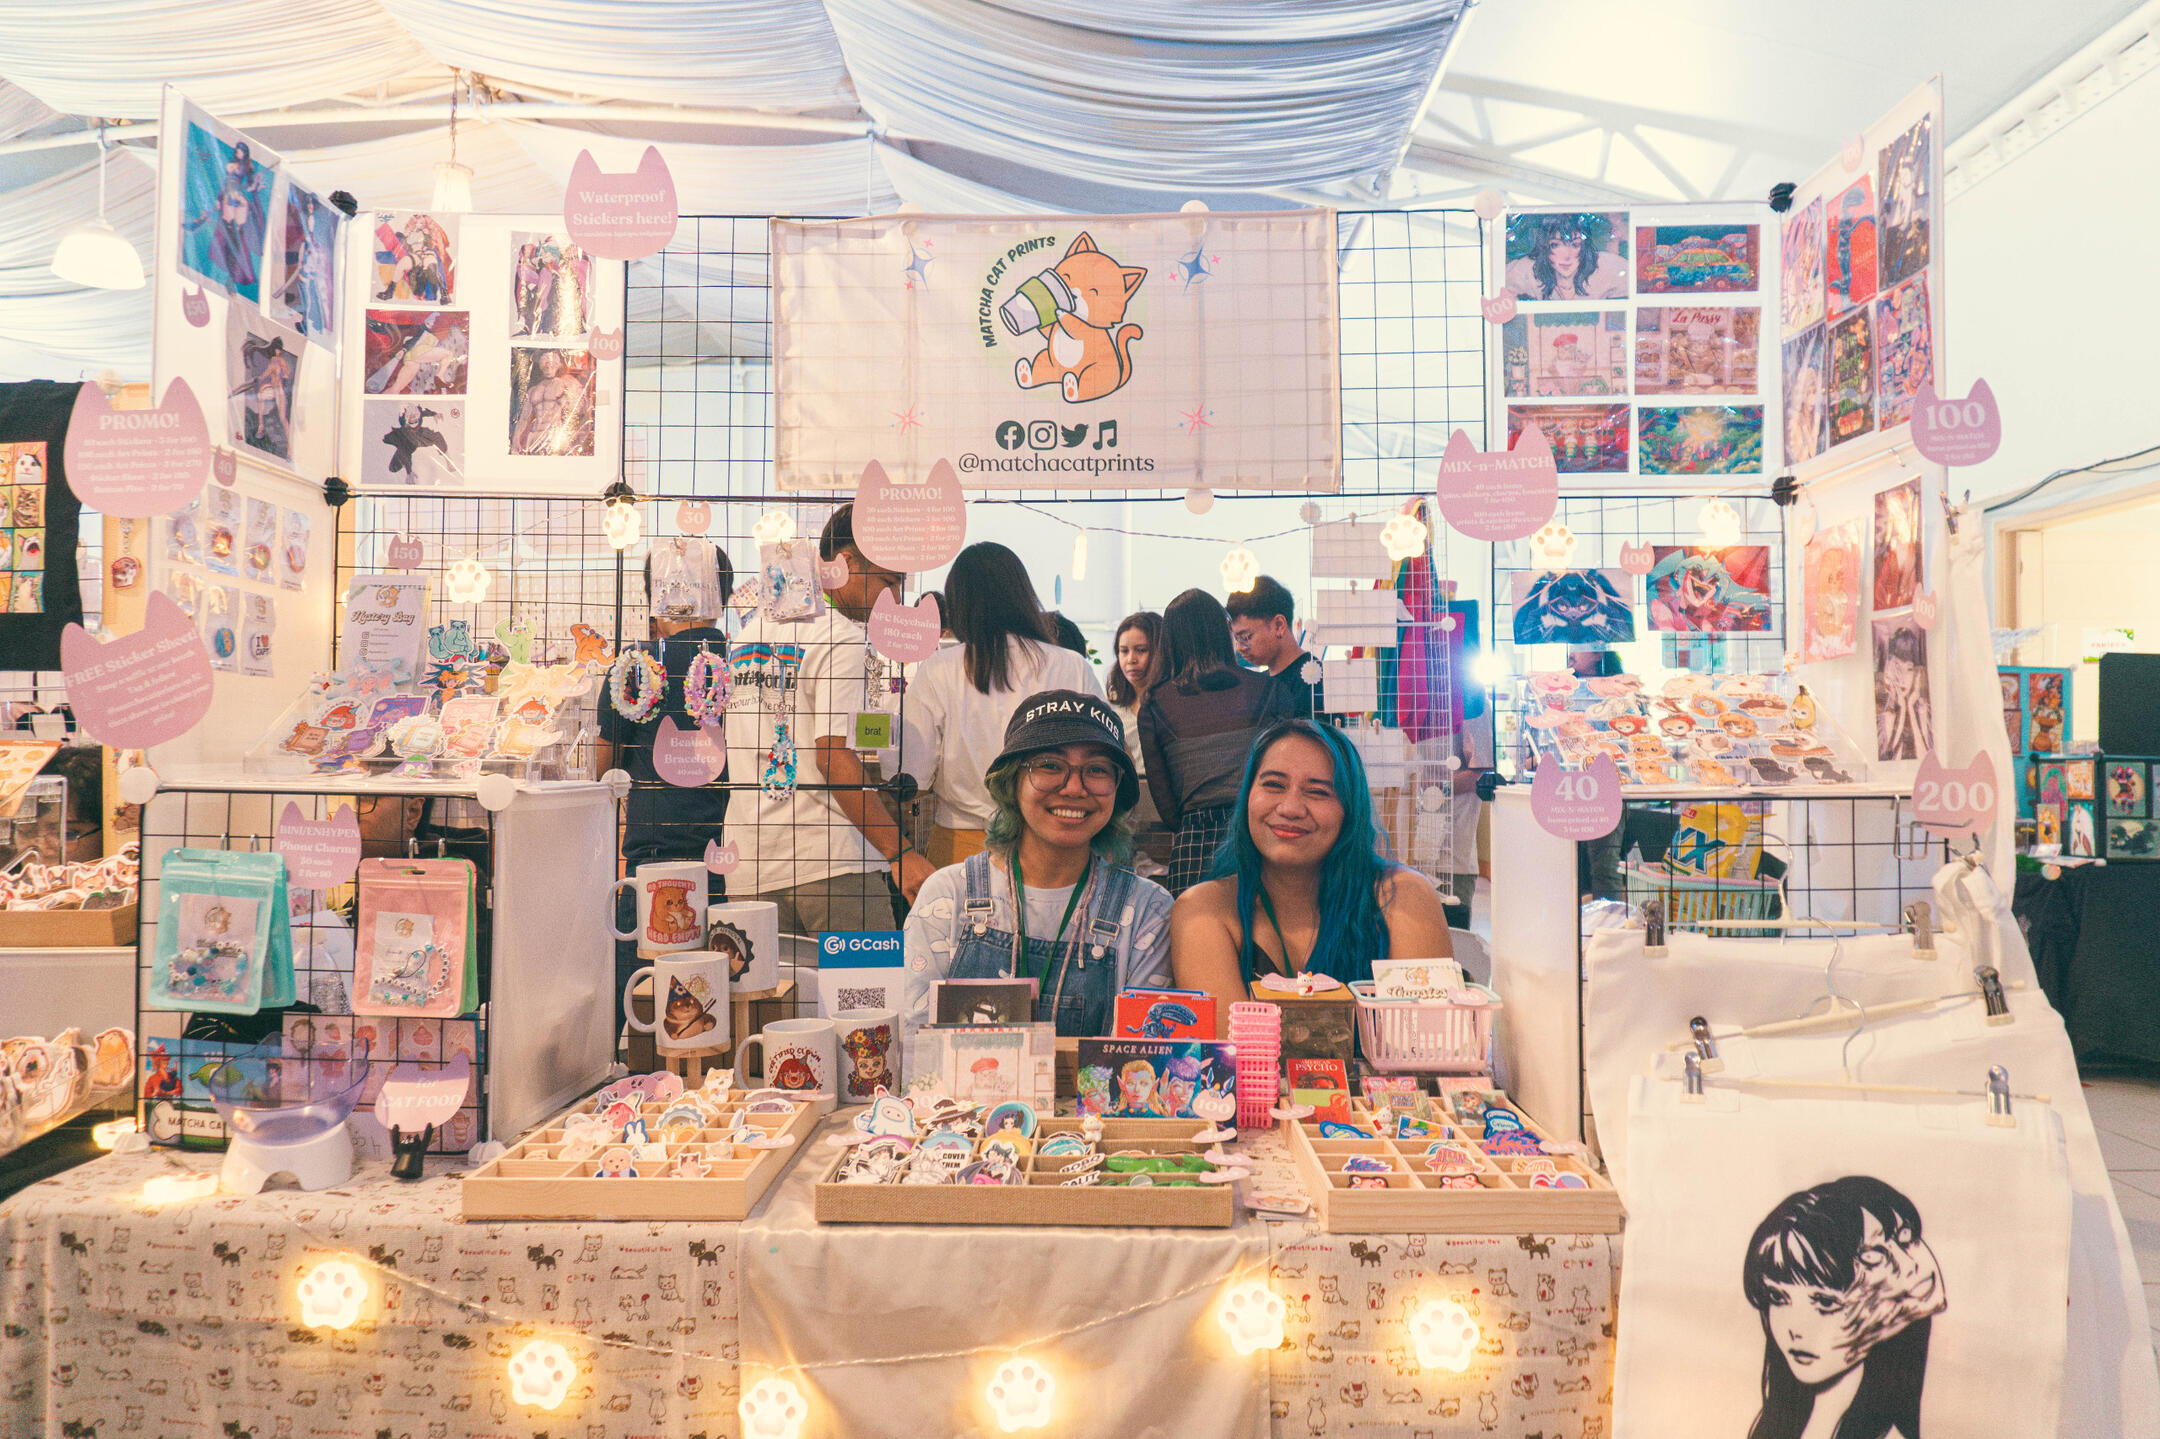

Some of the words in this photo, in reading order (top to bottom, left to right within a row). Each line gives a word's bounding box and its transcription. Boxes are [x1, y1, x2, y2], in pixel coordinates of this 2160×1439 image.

[579, 190, 666, 206] Waterproof
[573, 212, 633, 225] Stickers
[636, 211, 672, 225] here!
[1007, 236, 1056, 262] PRINTS
[986, 258, 1008, 286] CAT
[1487, 298, 1512, 317] 100
[978, 287, 998, 348] MATCHA
[594, 338, 619, 352] 100
[99, 412, 180, 430] PROMO!
[1926, 402, 1985, 430] 100
[958, 453, 1154, 476] @matchacatprints
[1443, 455, 1554, 473] MIX-n-MATCH!
[879, 487, 942, 500] PROMO!
[394, 546, 420, 560] 150
[1624, 553, 1650, 566] 100
[351, 609, 391, 625] Mystery
[392, 610, 415, 625] Bag
[871, 611, 892, 622] NFC
[884, 626, 900, 637] 180
[902, 632, 923, 640] each
[64, 663, 105, 688] FREE
[105, 647, 155, 673] Sticker
[1026, 700, 1085, 723] STRAY
[1090, 706, 1120, 741] KIDS
[864, 726, 882, 737] brat
[671, 735, 711, 747] Beaded
[664, 753, 717, 765] Bracelets
[1554, 775, 1599, 801] 40
[1918, 781, 1996, 812] 200
[280, 840, 313, 852] Phone
[315, 842, 358, 854] Charms
[709, 852, 735, 865] 150
[658, 879, 696, 890] THOUGHTS
[647, 927, 669, 943] HEAD
[849, 937, 900, 951] GCash
[1102, 1044, 1137, 1054] SPACE
[1140, 1044, 1173, 1055] ALIEN
[1295, 1063, 1338, 1072] PSYCHO
[381, 1095, 416, 1109] CAT
[416, 1093, 463, 1108] FOOD
[1199, 1100, 1231, 1113] 100
[168, 1116, 205, 1128] MATCHA
[209, 1120, 225, 1130] CA
[942, 1161, 961, 1169] THEM
